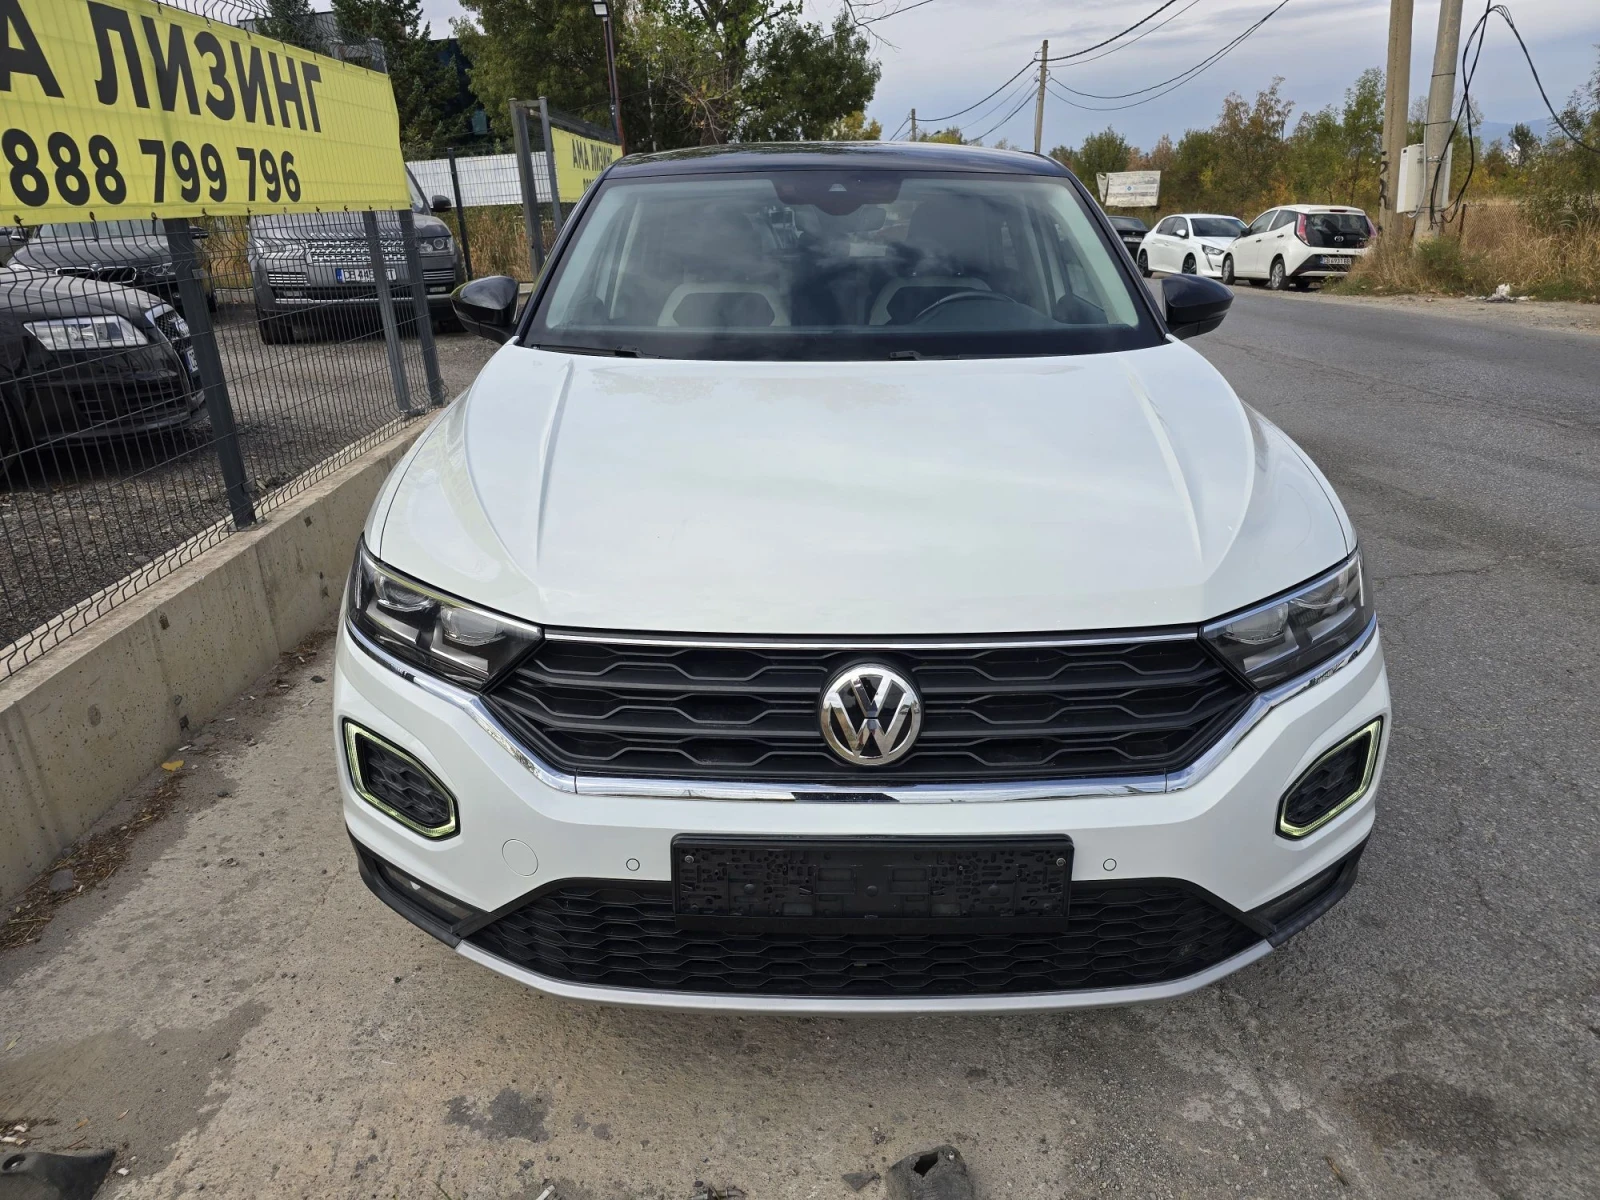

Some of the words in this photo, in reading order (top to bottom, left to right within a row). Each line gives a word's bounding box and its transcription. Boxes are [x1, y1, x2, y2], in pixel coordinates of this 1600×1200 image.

[87, 0, 322, 132] ЛИЗИНГ
[2, 129, 126, 207] 888
[139, 139, 227, 203] 799
[237, 147, 301, 203] 796
